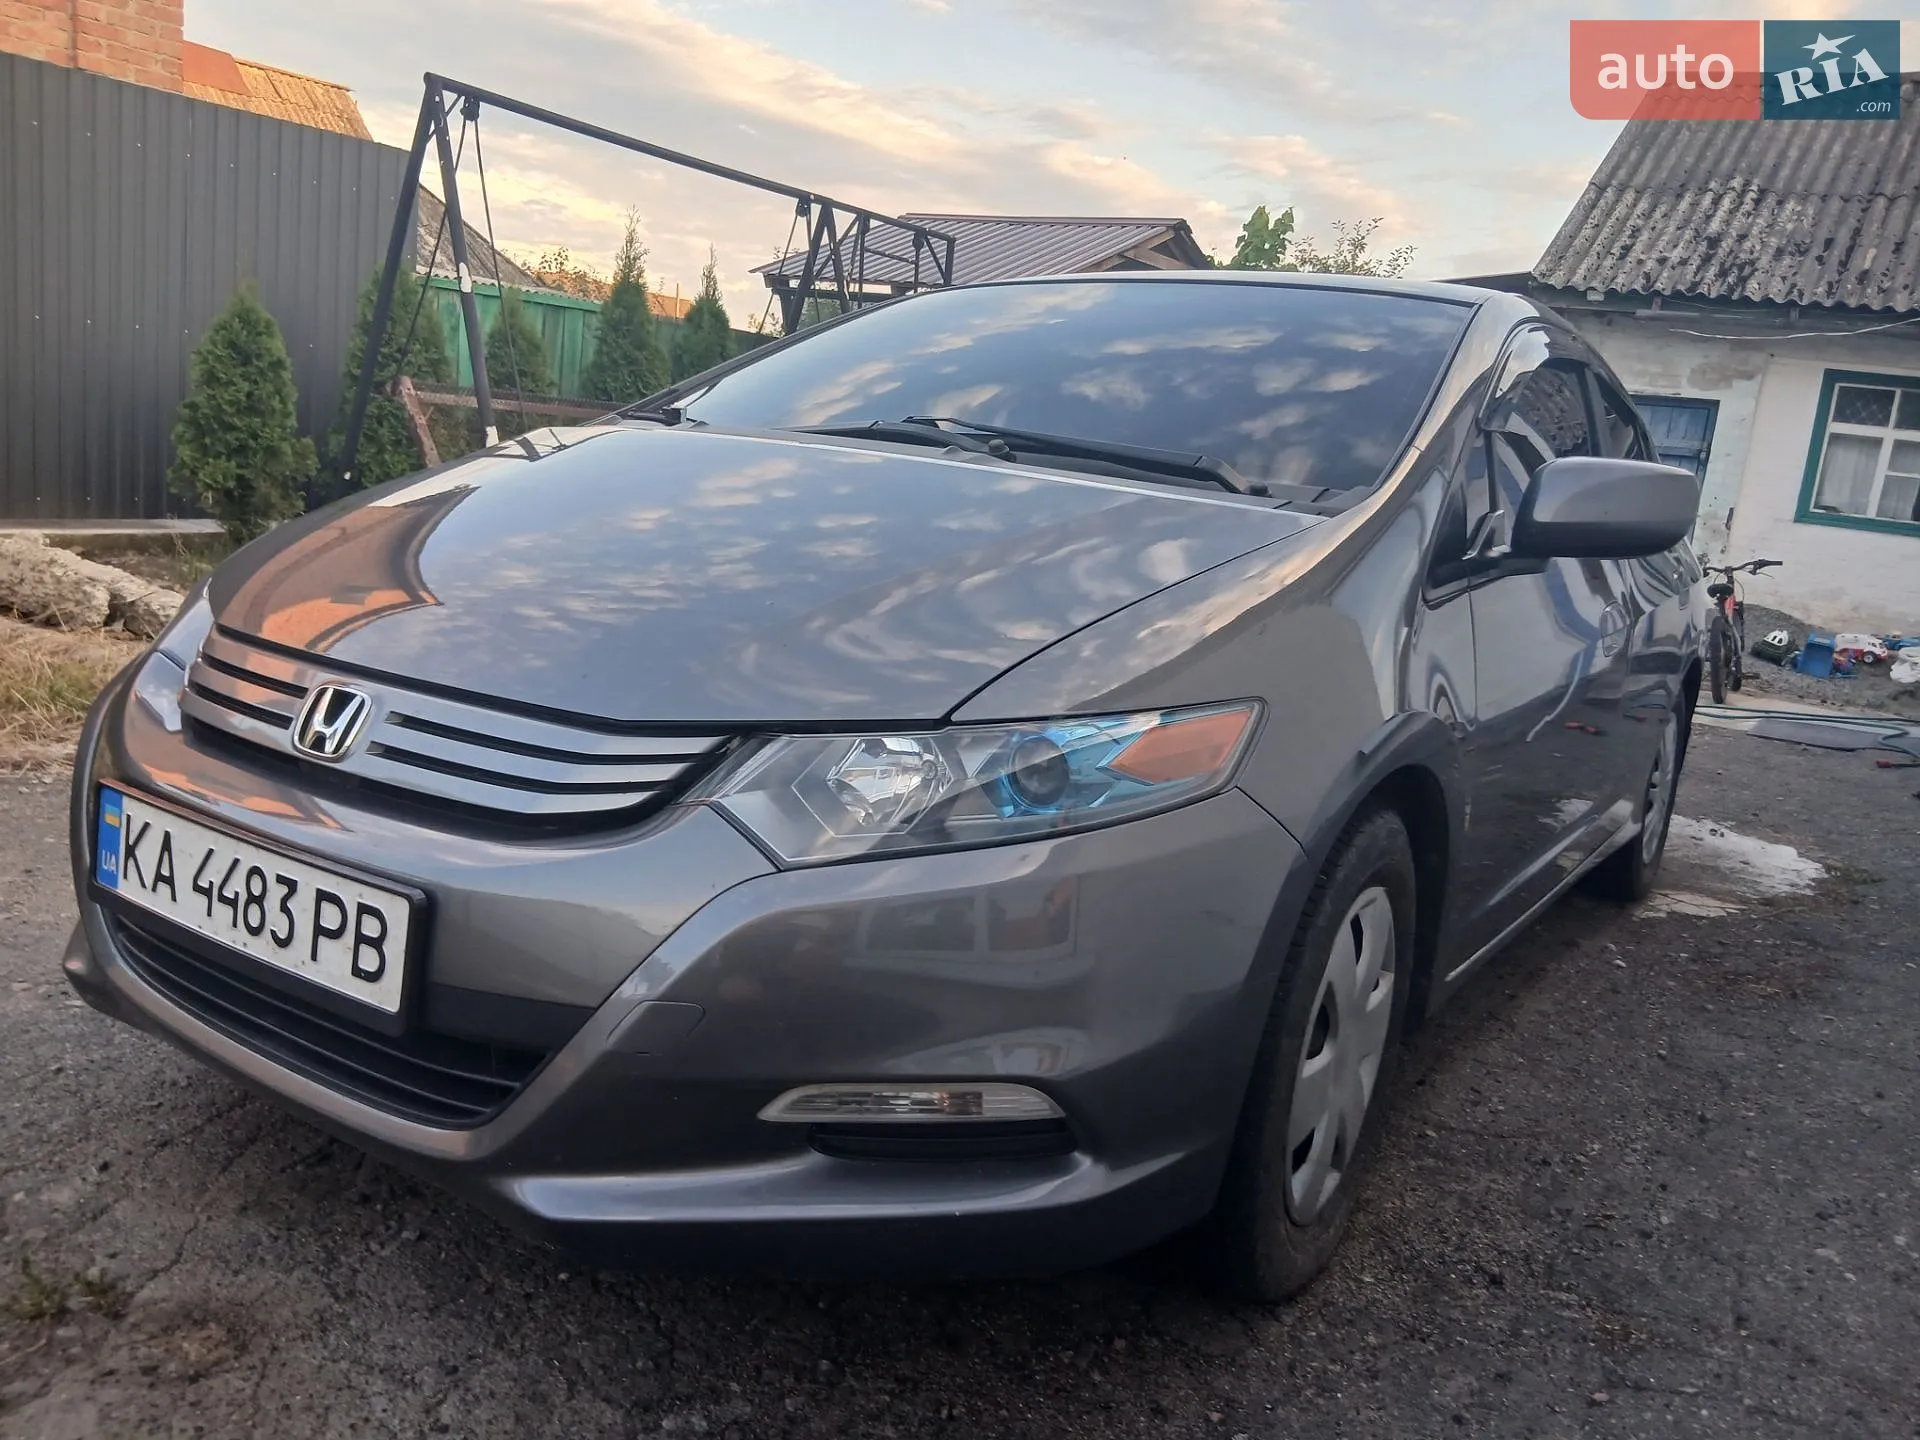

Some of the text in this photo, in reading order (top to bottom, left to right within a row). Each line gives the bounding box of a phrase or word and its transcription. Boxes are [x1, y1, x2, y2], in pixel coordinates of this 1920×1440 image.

[102, 850, 117, 874] UA
[122, 813, 388, 983] KA 4483 PB
